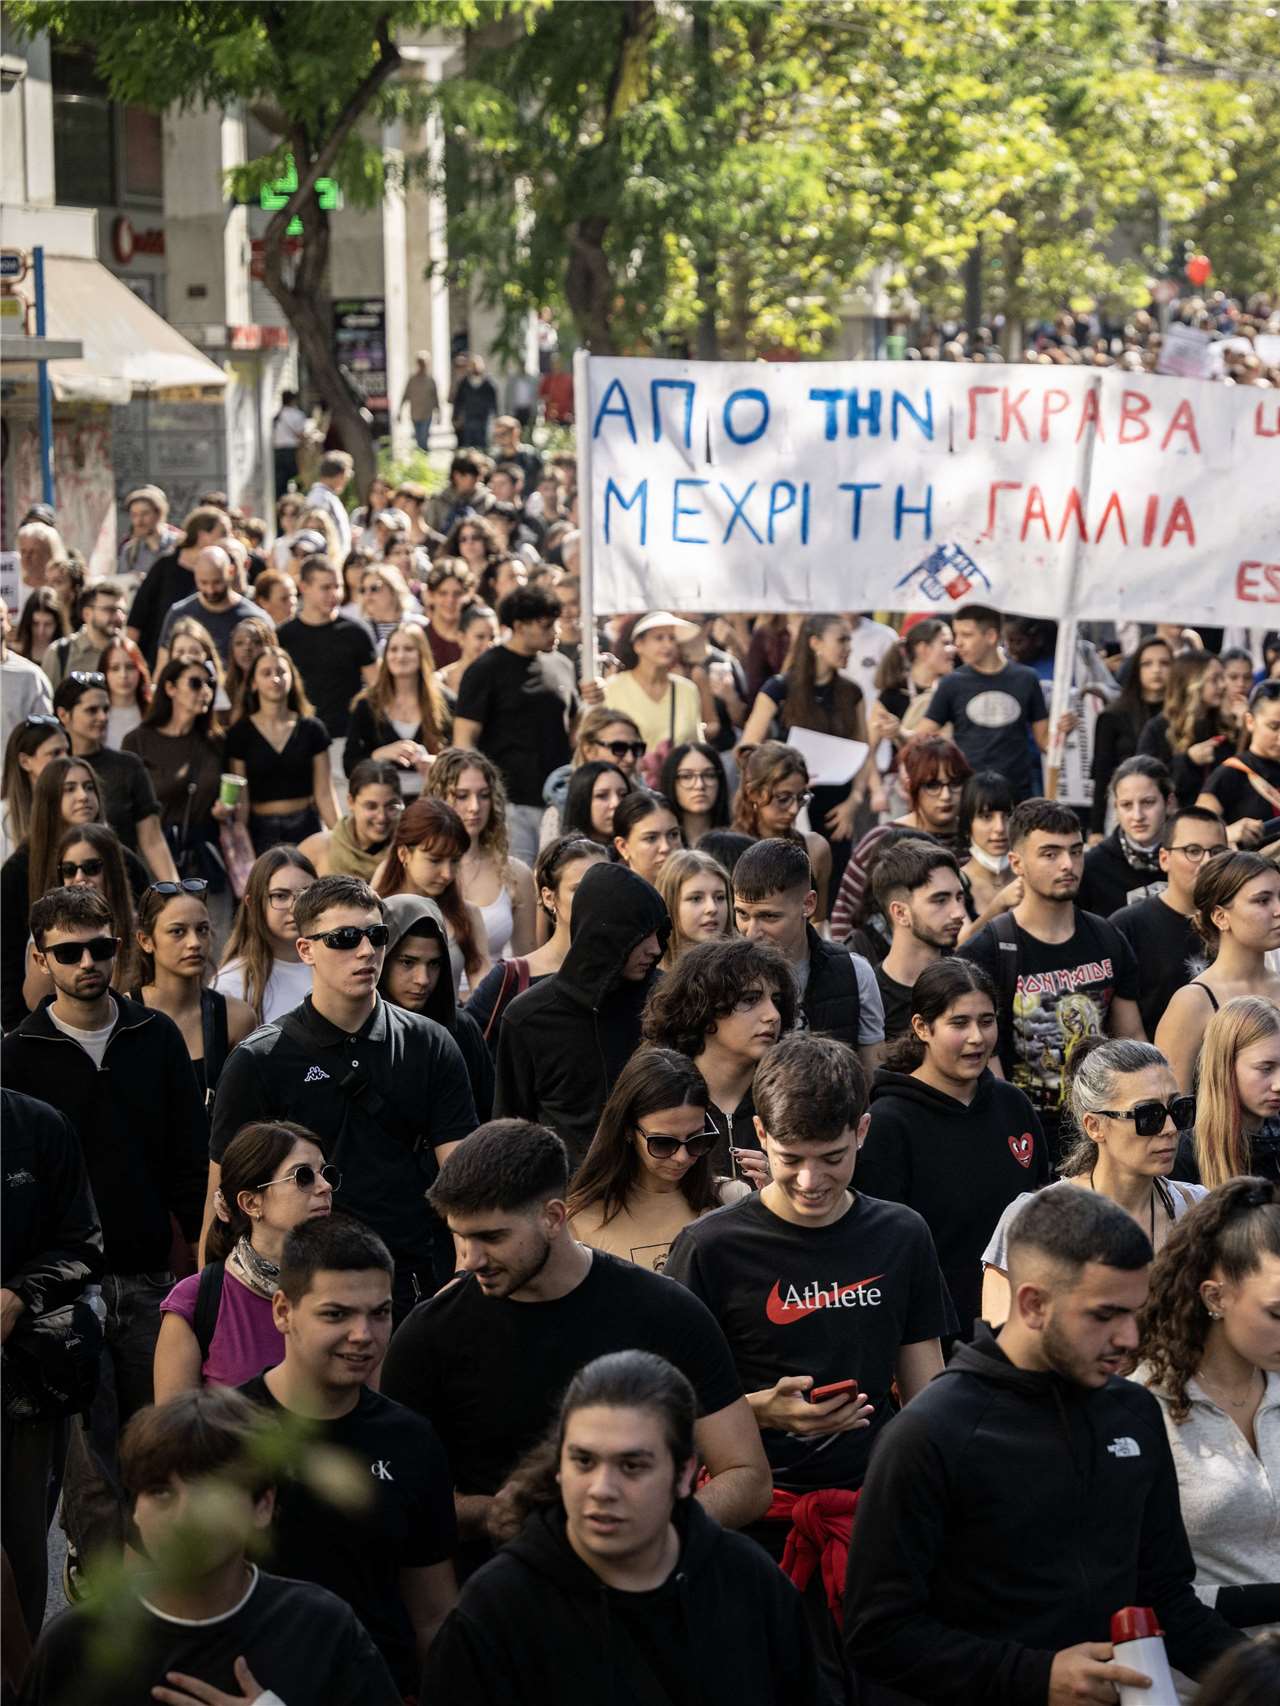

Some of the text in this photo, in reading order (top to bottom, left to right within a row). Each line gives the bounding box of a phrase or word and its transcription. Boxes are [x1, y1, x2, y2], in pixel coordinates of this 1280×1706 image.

[593, 378, 1200, 454] ΑΠΟ ΤΗΝ ΓΚΡΑΒΑ
[604, 477, 1196, 547] ΜΕΧΡΙ ΤΗ ΓΑΛΛΙΑ
[1056, 958, 1114, 993] MAIDE
[781, 1280, 882, 1310] Athlete
